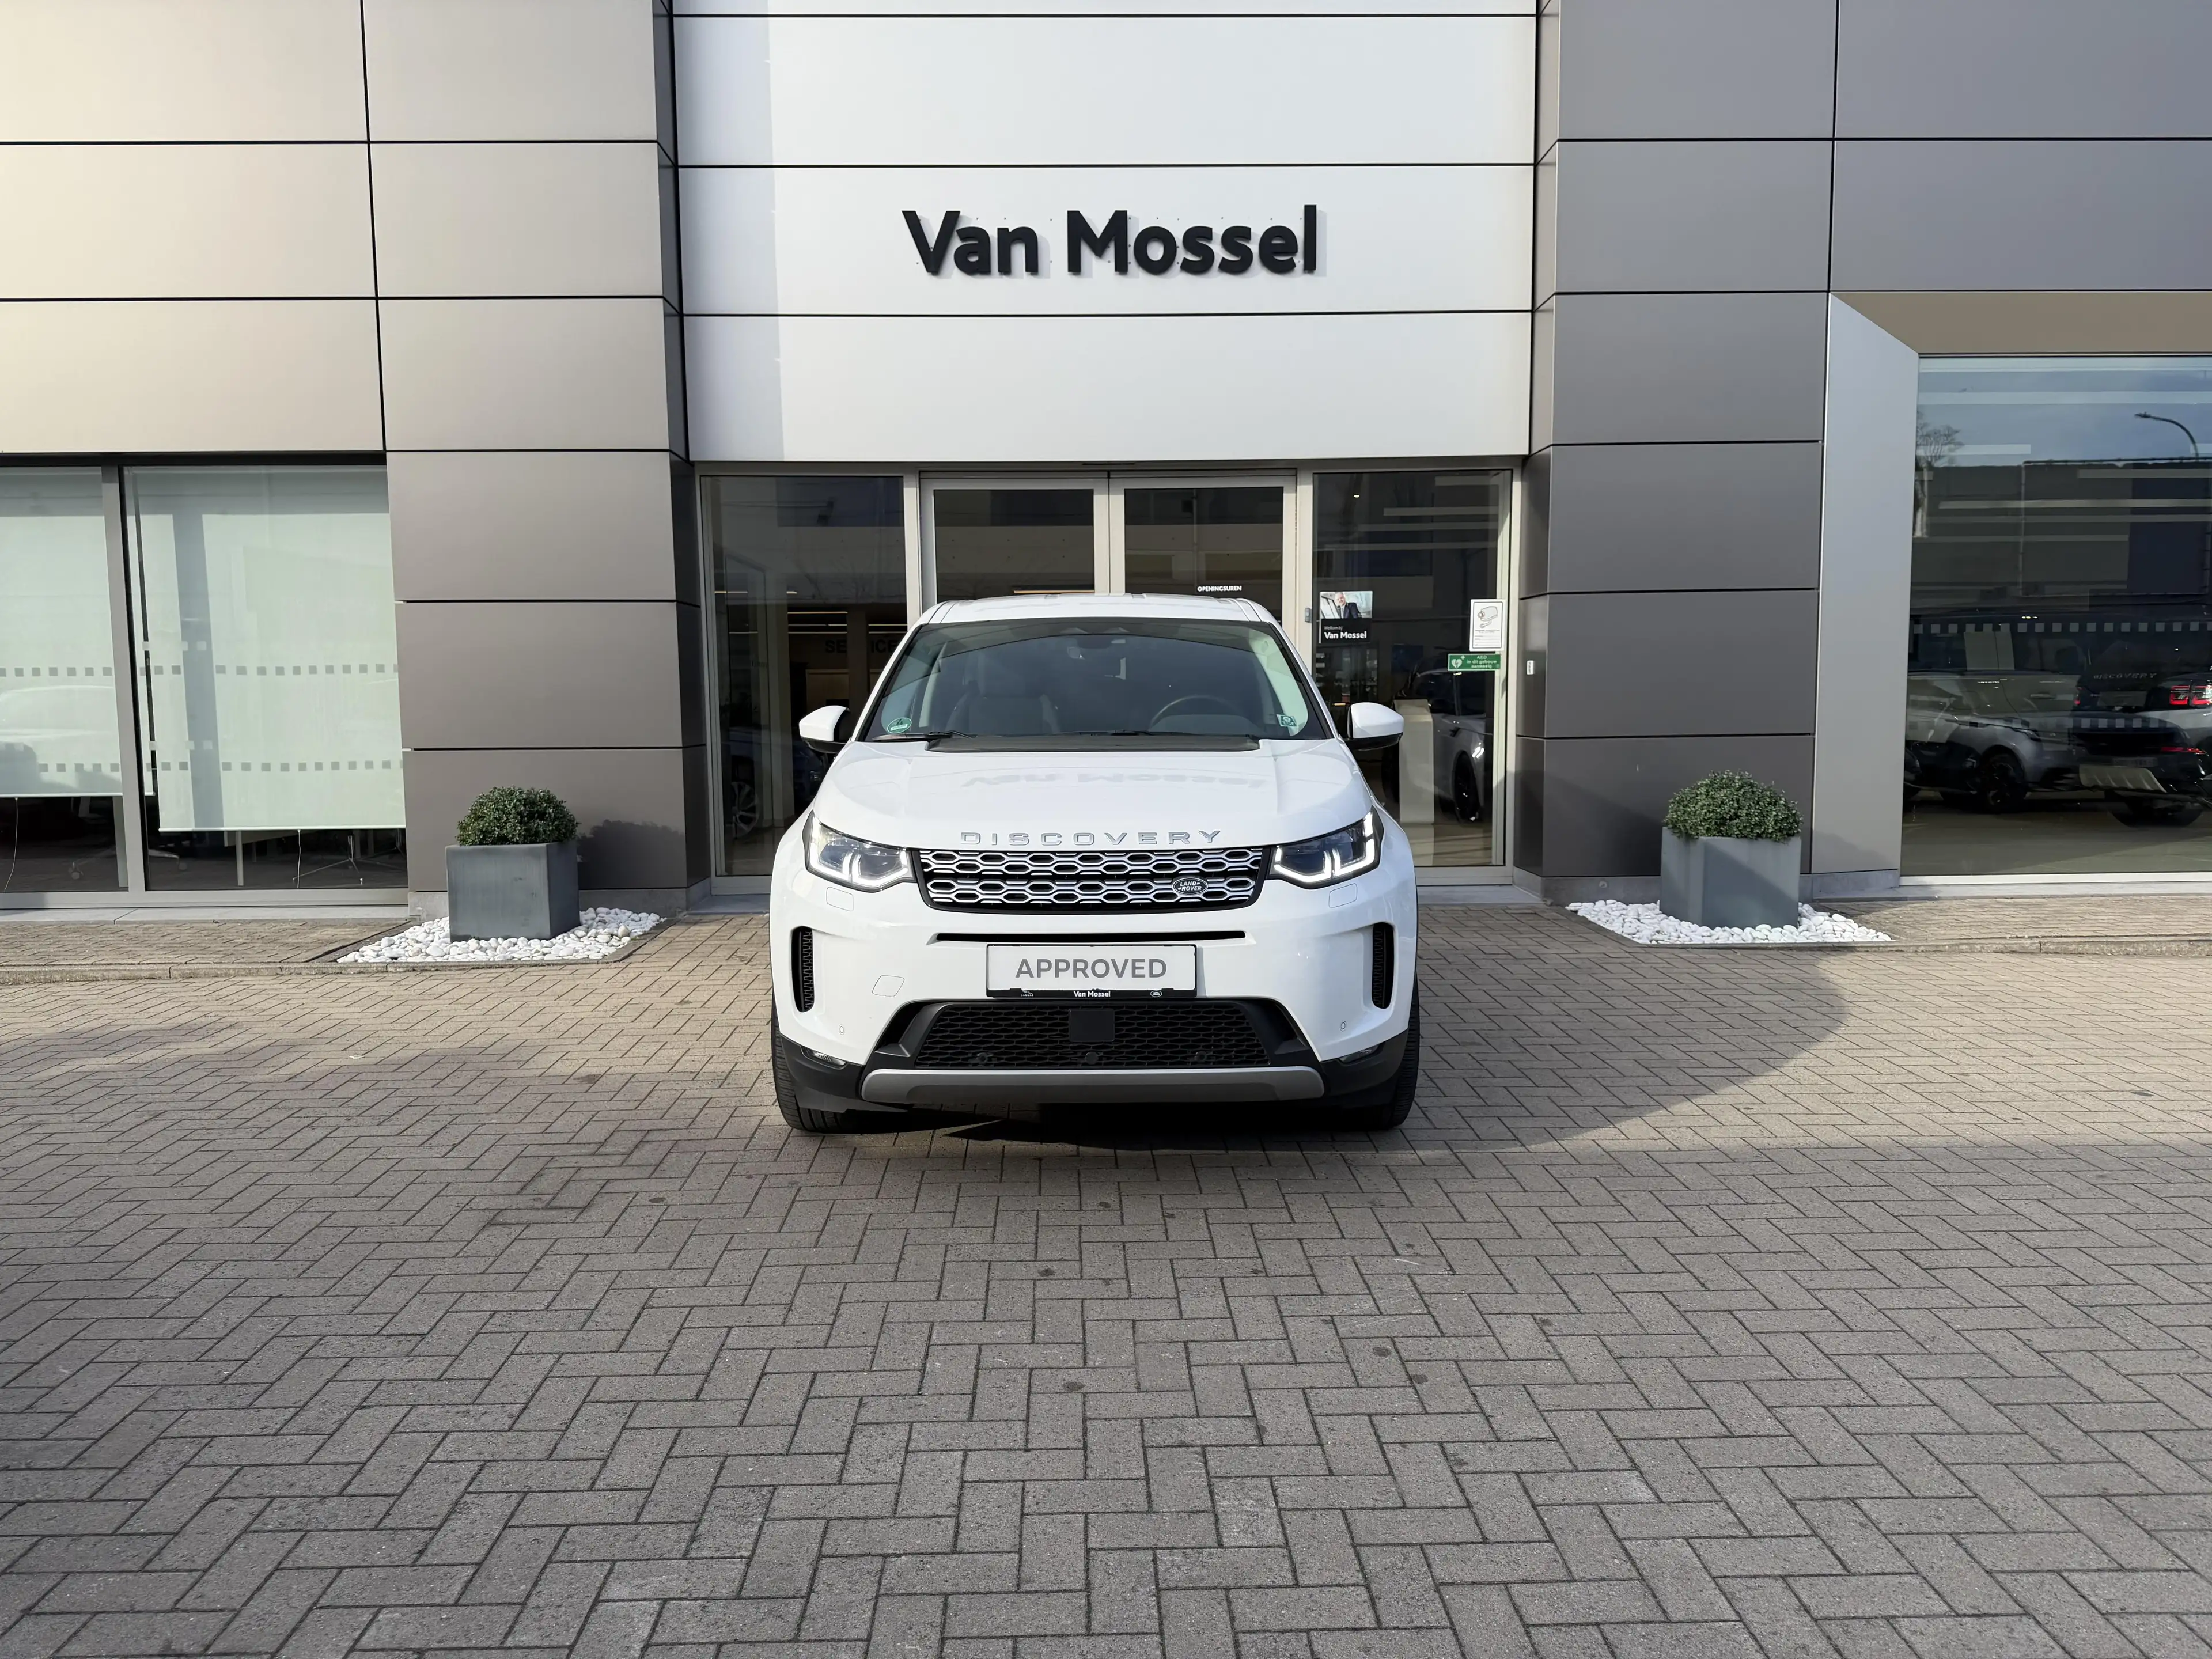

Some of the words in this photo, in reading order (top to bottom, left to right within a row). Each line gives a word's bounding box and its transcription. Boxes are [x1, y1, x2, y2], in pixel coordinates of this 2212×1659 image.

[902, 210, 1038, 275] Van
[1067, 204, 1317, 275] Mossel
[1340, 631, 1367, 639] Mossel
[825, 639, 899, 653] SEICE
[960, 830, 1221, 846] DISCOVERY
[1016, 958, 1167, 979] APPROVED
